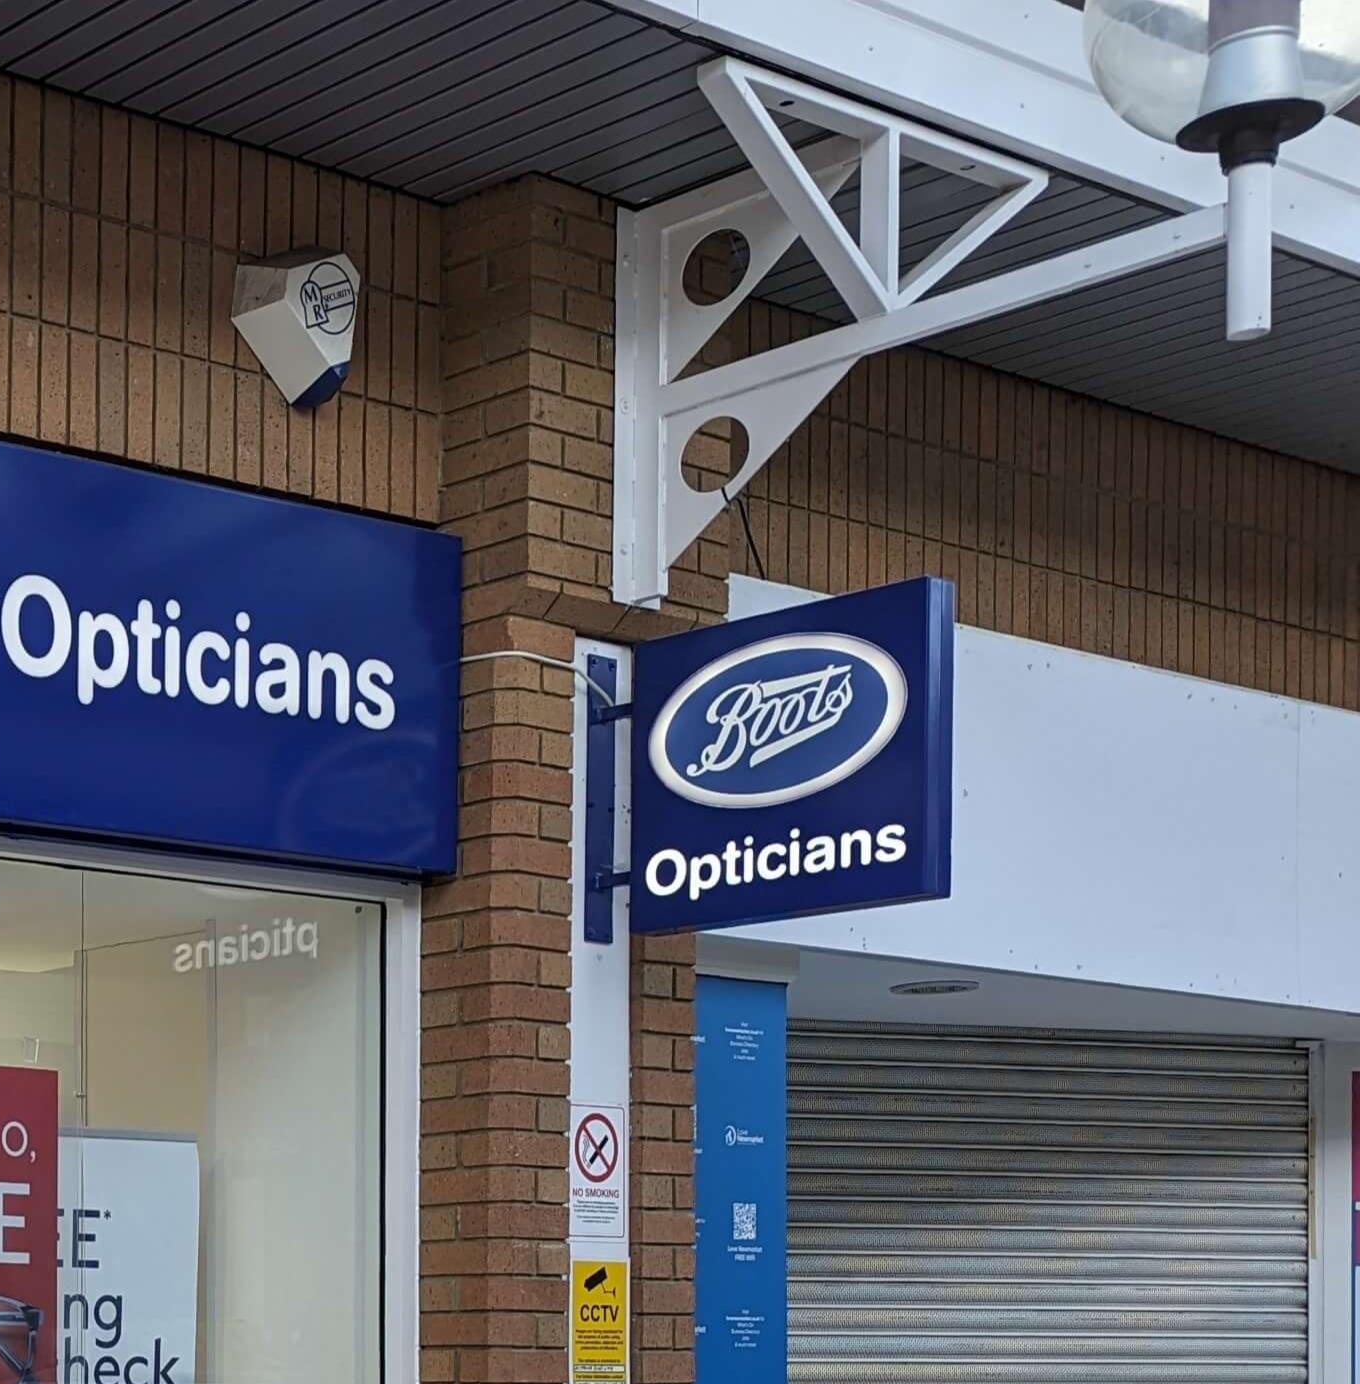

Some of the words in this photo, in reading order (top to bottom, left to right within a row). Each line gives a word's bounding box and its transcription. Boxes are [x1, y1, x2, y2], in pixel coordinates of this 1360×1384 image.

[323, 288, 352, 302] SECURITY
[0, 573, 397, 732] Opticians
[686, 663, 854, 778] Boots
[644, 823, 908, 900] Opticians
[572, 1187, 584, 1198] NO
[584, 1187, 620, 1199] SMOKING
[579, 1304, 620, 1323] CCTV
